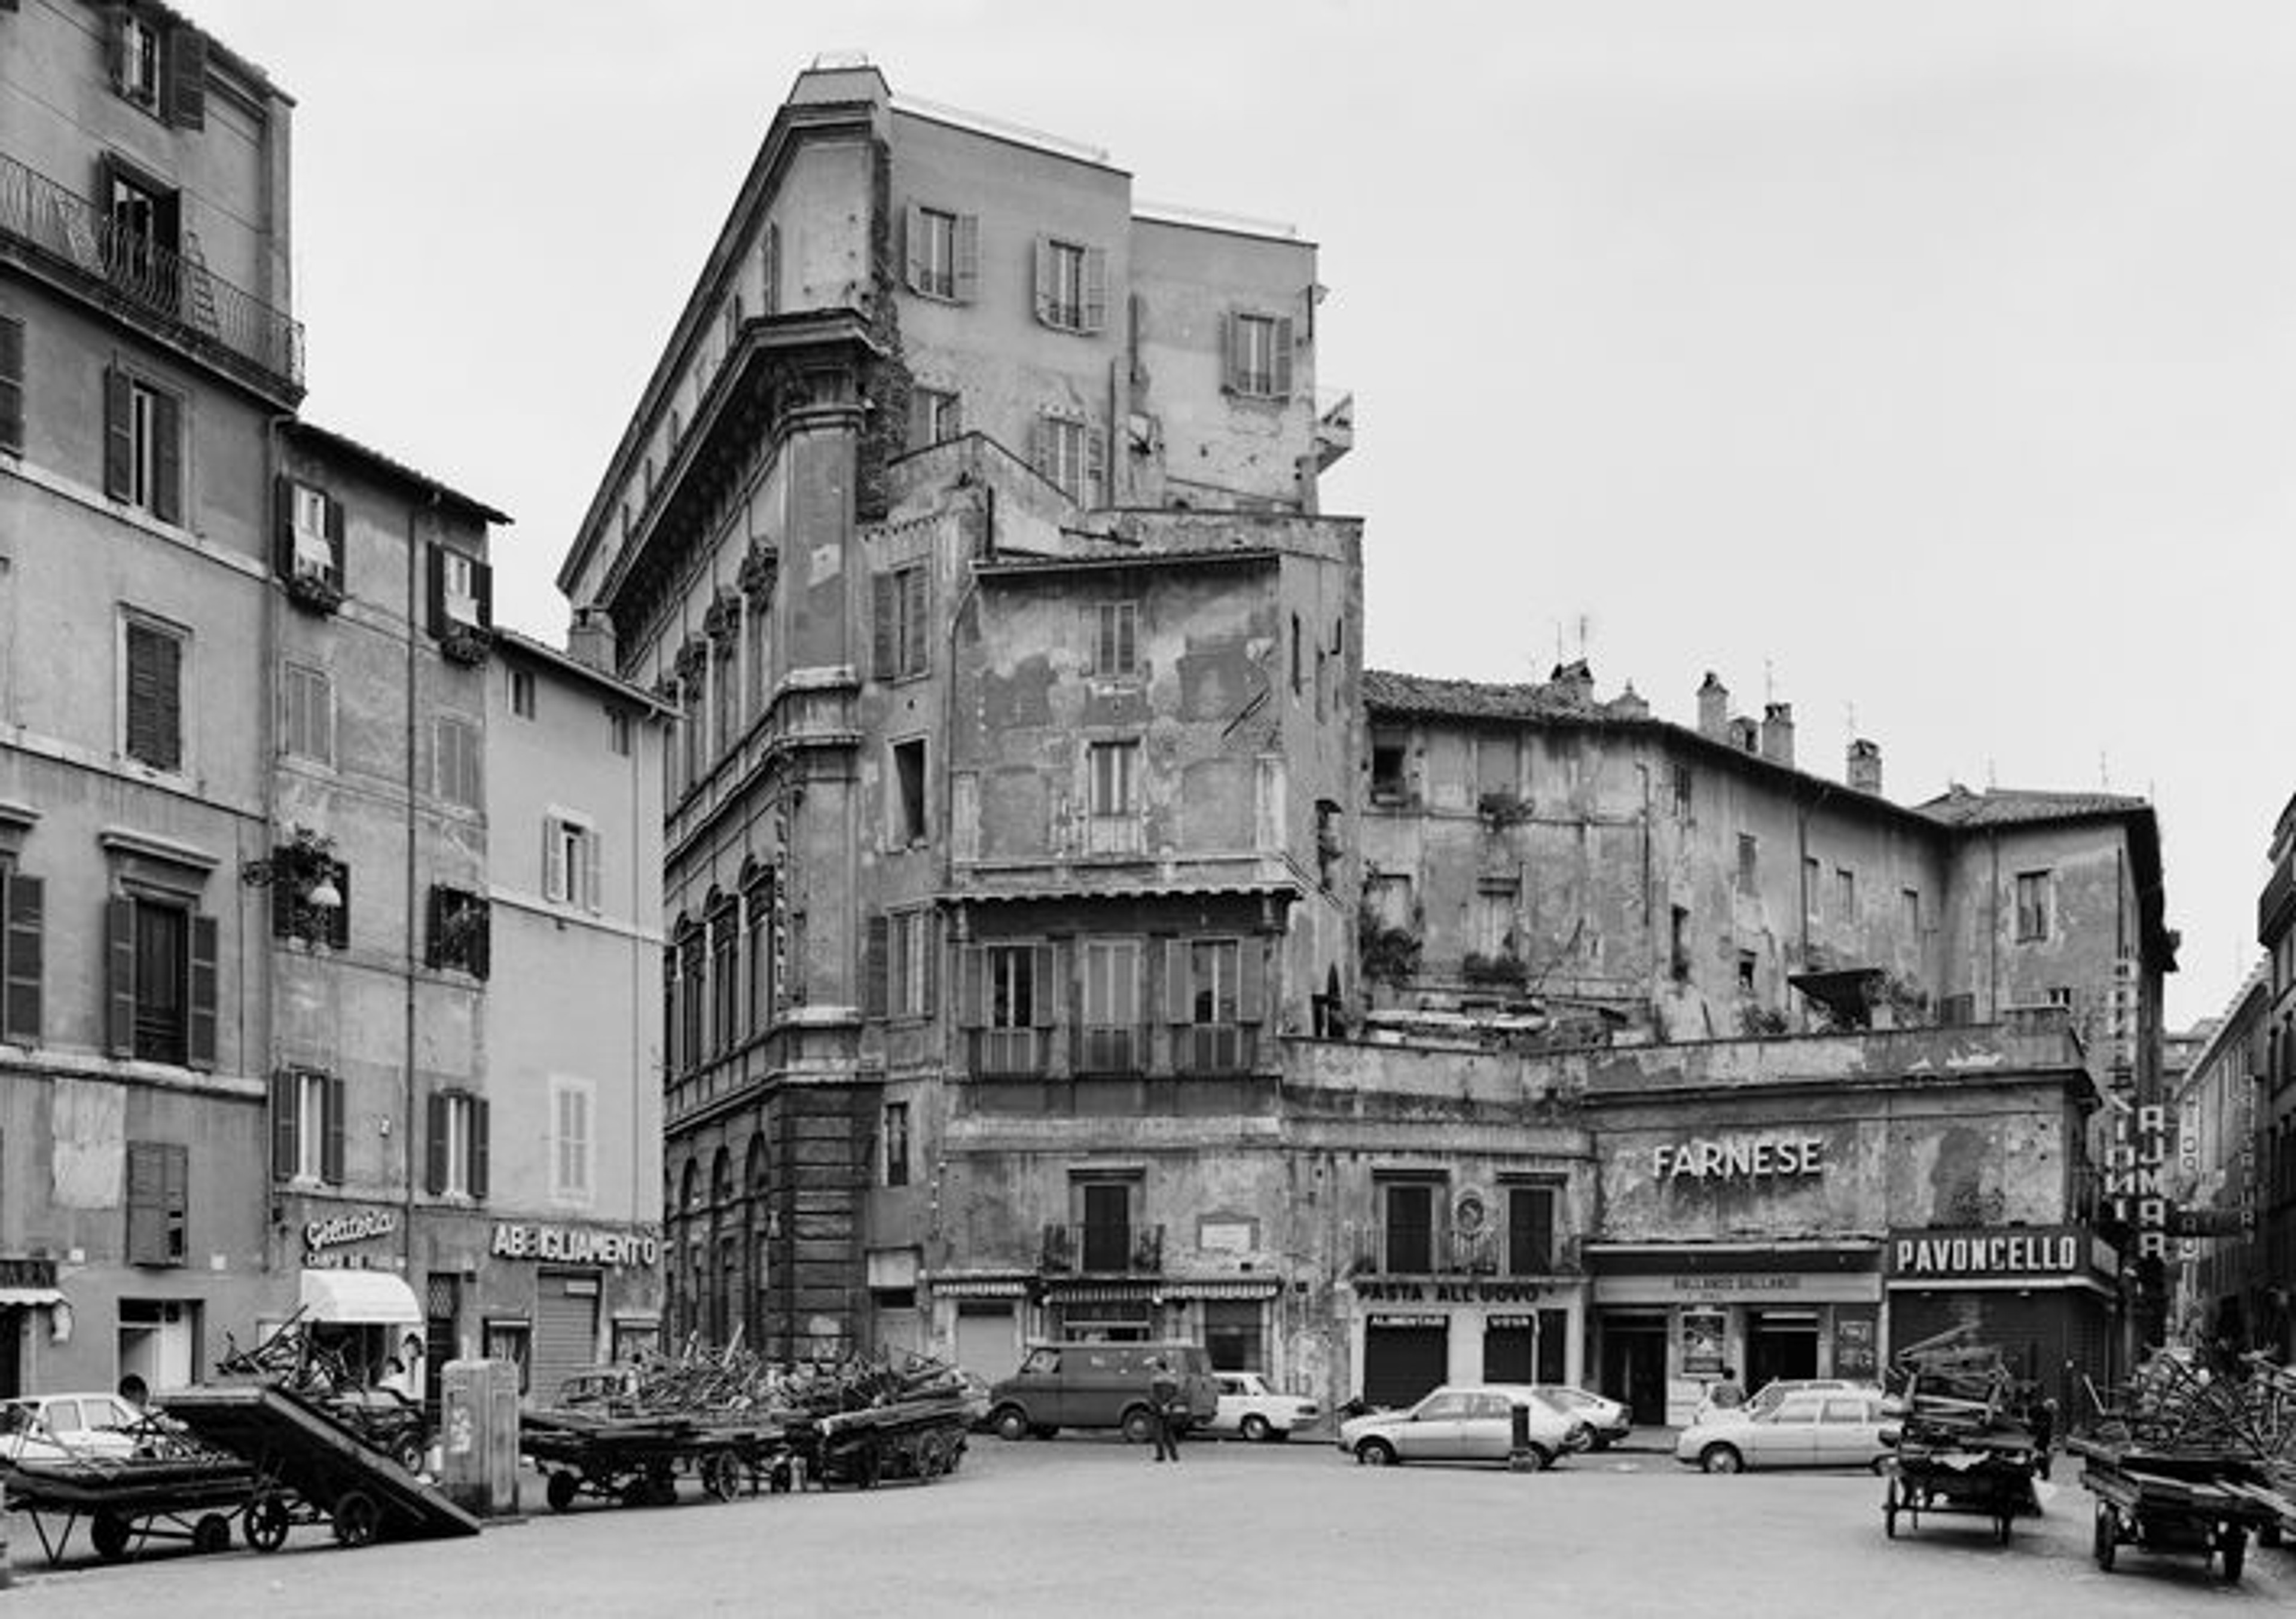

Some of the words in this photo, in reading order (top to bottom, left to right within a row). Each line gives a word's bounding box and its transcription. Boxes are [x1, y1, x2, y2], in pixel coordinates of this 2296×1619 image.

[1654, 1138, 1821, 1178] FARNESE
[493, 1223, 655, 1265] ABBIGLIAMENTO
[1897, 1236, 2077, 1272] PAVONCELLO
[1357, 1283, 1423, 1302] PASTA
